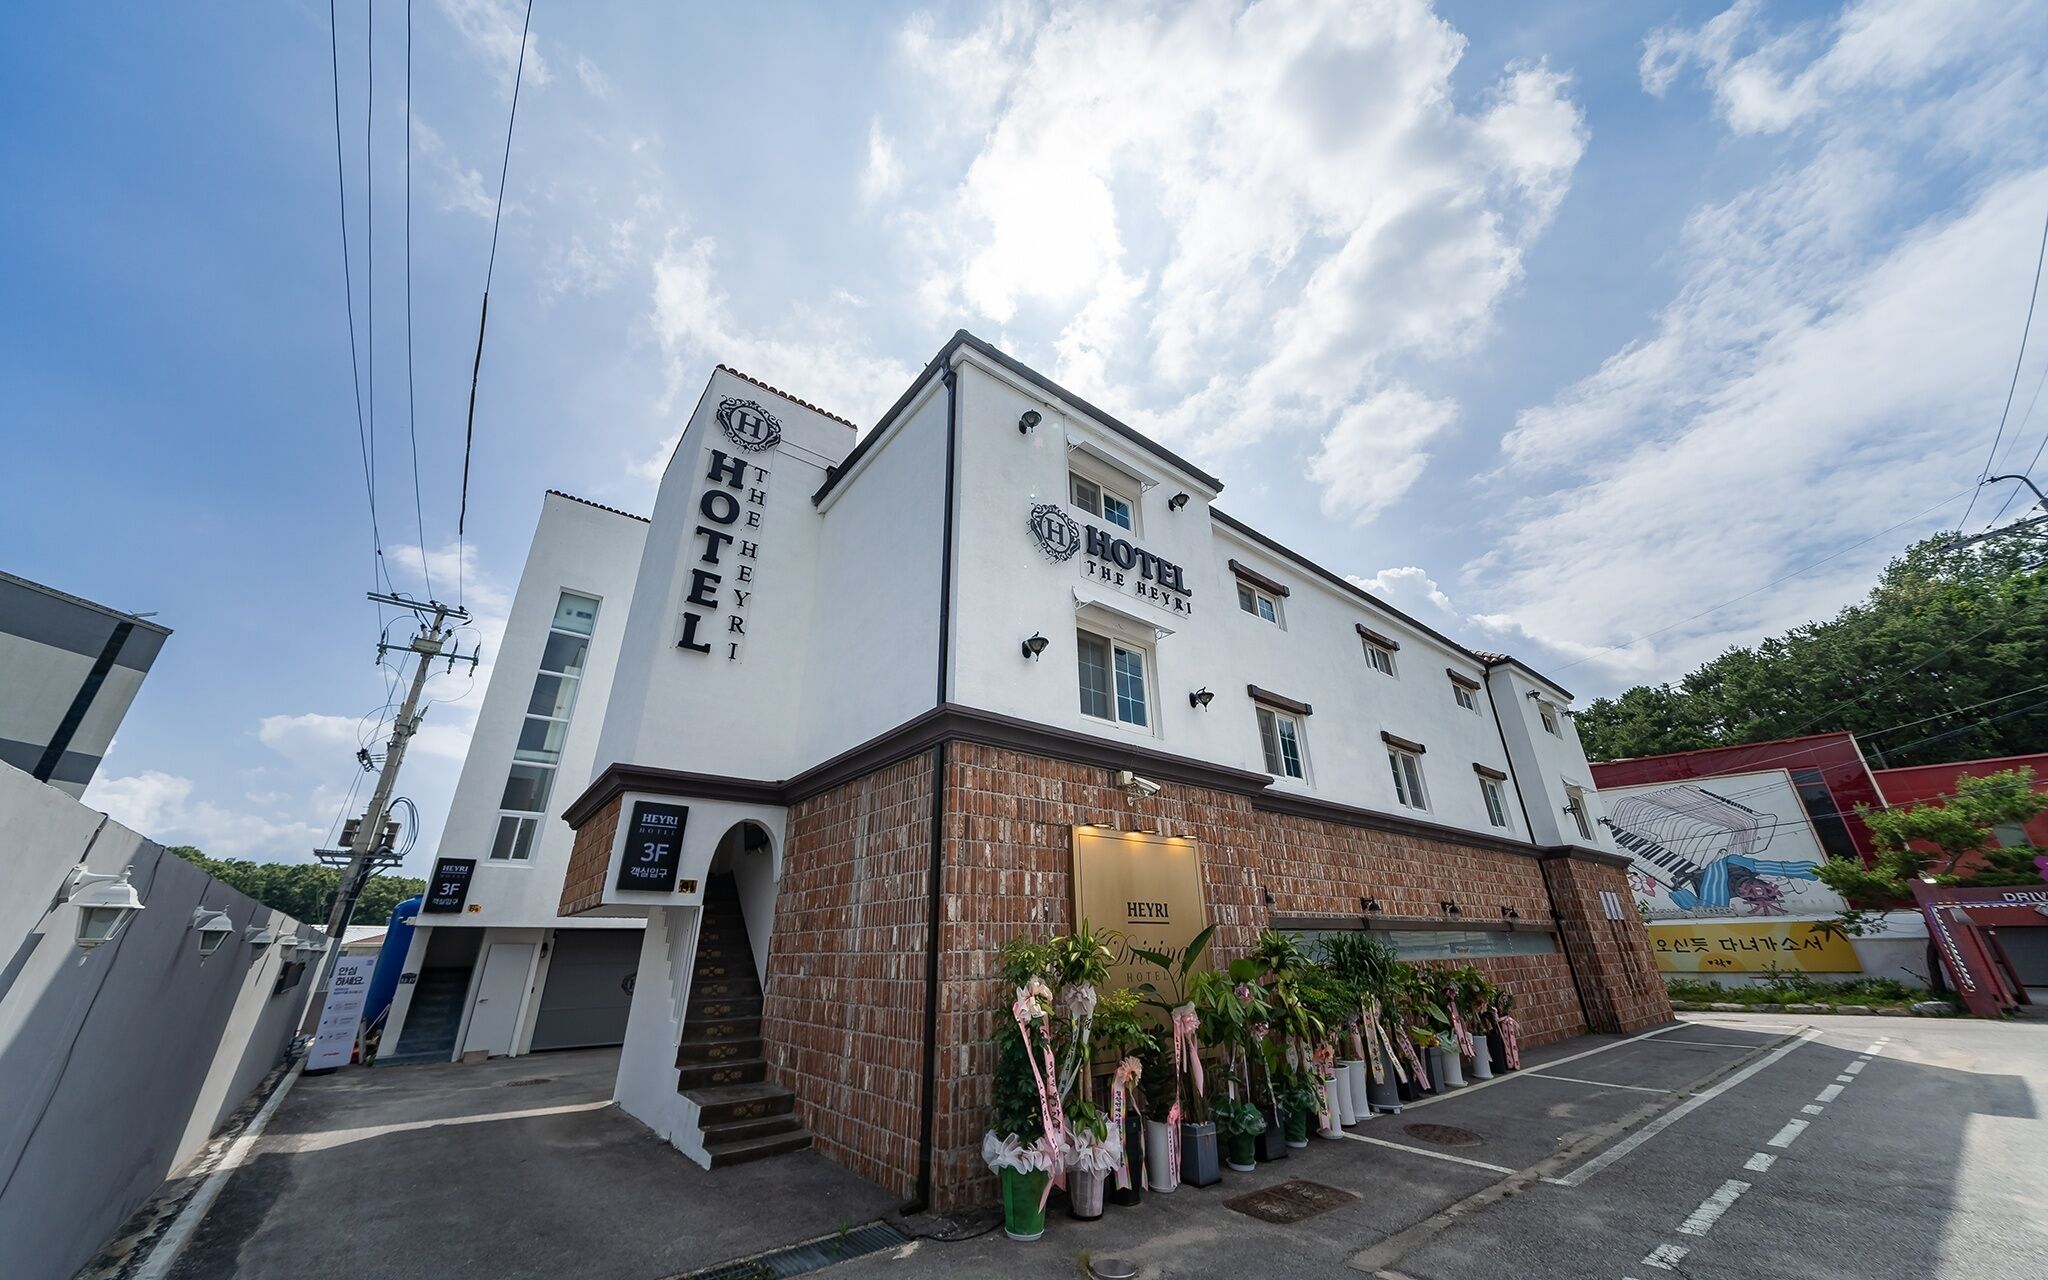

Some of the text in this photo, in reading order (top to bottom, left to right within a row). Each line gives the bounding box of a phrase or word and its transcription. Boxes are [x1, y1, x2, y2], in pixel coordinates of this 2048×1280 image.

[738, 410, 762, 440] H
[1045, 516, 1066, 547] H
[677, 448, 748, 655] HOTEL
[727, 466, 771, 661] THE HEYRI
[1085, 524, 1192, 597] HOTEL
[1087, 560, 1192, 615] THE HEYRI
[641, 813, 679, 826] HEYRI
[640, 842, 670, 862] 3F
[442, 864, 469, 872] HEYRI
[439, 883, 461, 896] 3F
[2002, 891, 2048, 902] DRIV
[1127, 902, 1169, 918] HEYRI
[1656, 936, 1823, 953] 오신듯 다녀가소서
[338, 966, 358, 976] 안심
[1126, 971, 1169, 982] HOTEL
